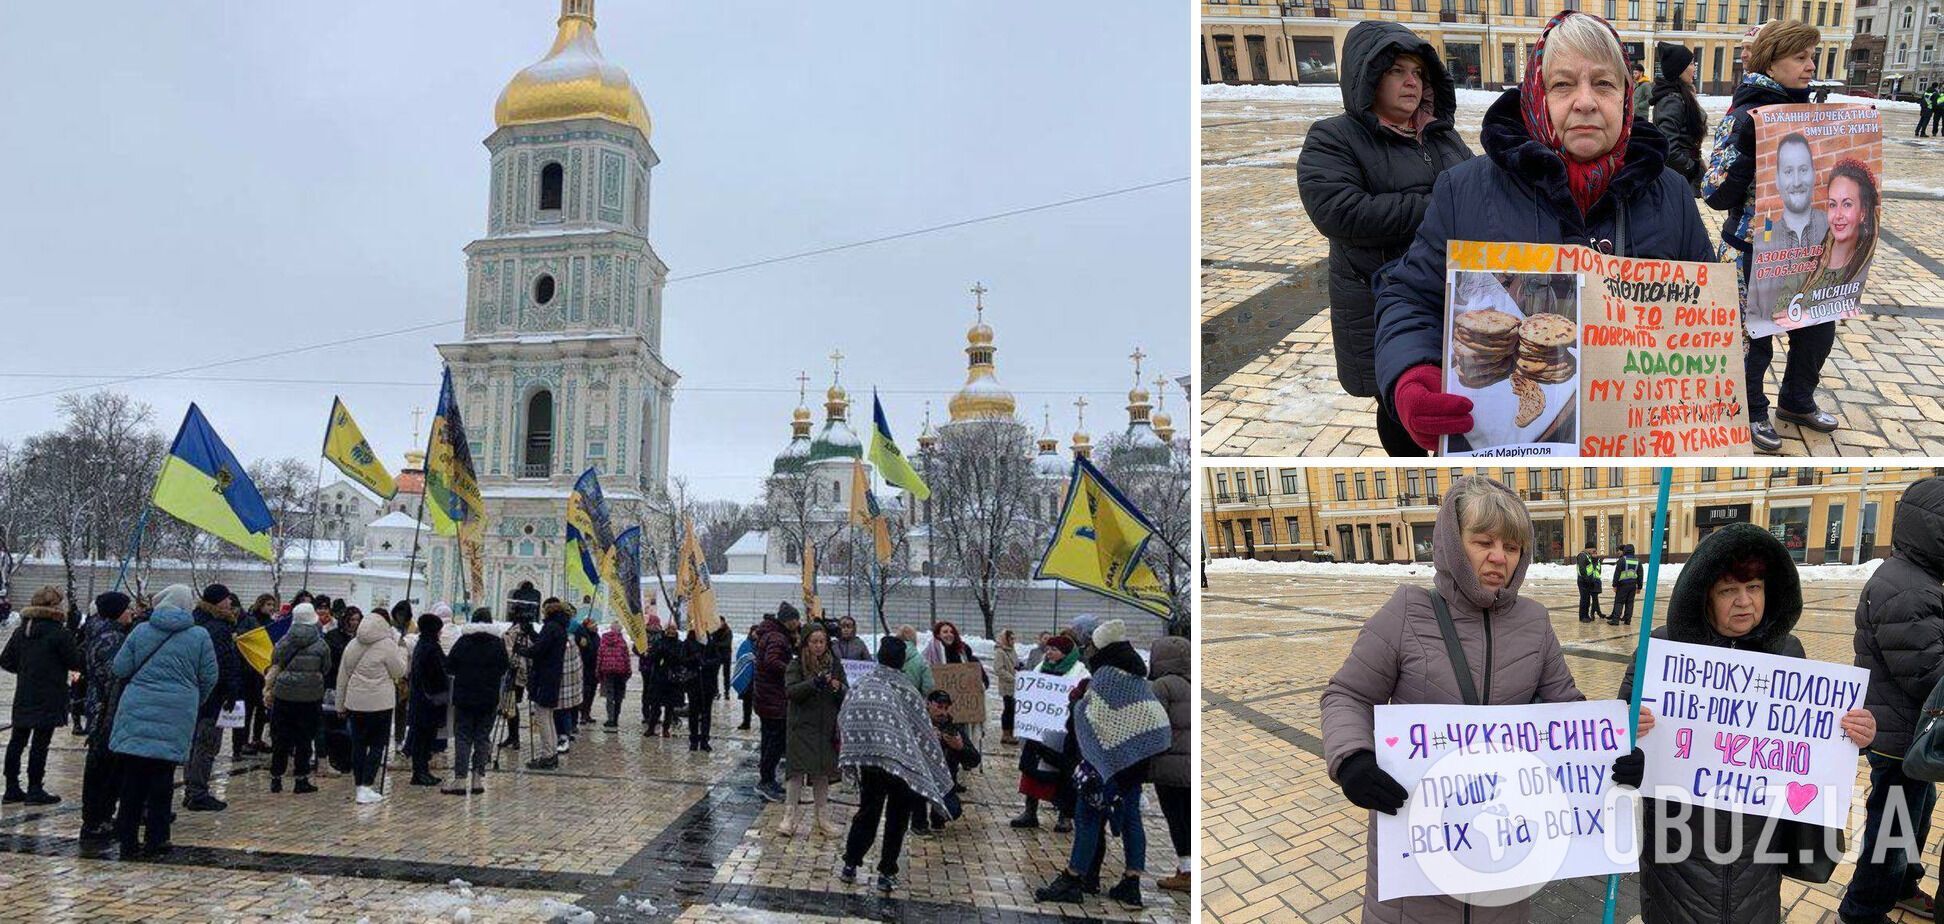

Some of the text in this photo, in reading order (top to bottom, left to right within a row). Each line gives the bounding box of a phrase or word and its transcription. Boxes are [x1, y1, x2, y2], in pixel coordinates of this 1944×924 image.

[1763, 108, 1878, 124] БАЖАННЯ ДОЧЕКАТИСЯ
[1804, 123, 1879, 137] ЗМУШУЄ ЖИТИ
[1450, 241, 1555, 271] ЧЕКАЮ
[1756, 245, 1823, 264] АЗОВСТАЛЬ
[1556, 247, 1605, 274] МОЯ
[1697, 266, 1708, 287] В
[1756, 261, 1818, 279] 07.05.2022
[1811, 282, 1860, 302] МІСЯЦІВ
[1633, 306, 1663, 327] 70
[1787, 292, 1804, 322] 6
[1809, 299, 1857, 319] ПОЛОНУ
[1623, 349, 1728, 375] ДОДОМУ!
[1589, 379, 1625, 401] MY
[1496, 446, 1551, 457] Маріуполя
[1582, 434, 1628, 457] SHE
[1650, 430, 1675, 456] 70
[1679, 426, 1729, 452] YEARS
[1730, 426, 1750, 444] OLD
[1768, 704, 1834, 740] БОЛЮ
[1674, 728, 1693, 759] Я
[1421, 771, 1498, 808] ПРОШУ
